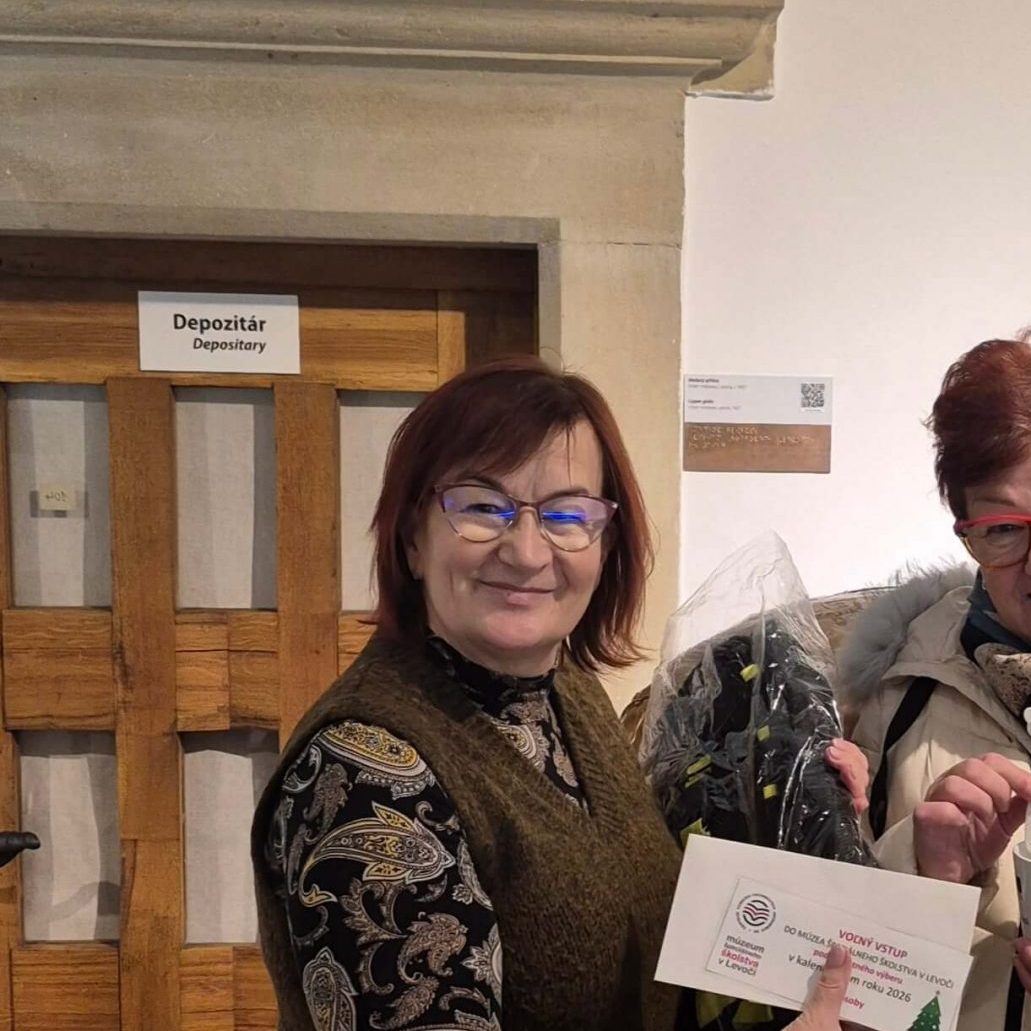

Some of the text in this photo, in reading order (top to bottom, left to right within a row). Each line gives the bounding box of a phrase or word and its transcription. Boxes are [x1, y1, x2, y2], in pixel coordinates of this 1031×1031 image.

[173, 313, 267, 335] Depozitár
[193, 337, 266, 354] Depositary
[784, 925, 796, 936] DO
[726, 935, 765, 953] múzeum
[875, 941, 908, 959] VSTUP
[720, 948, 759, 968] školstva
[725, 959, 757, 976] Levoči
[788, 954, 794, 962] v
[862, 978, 884, 994] roku
[886, 986, 912, 1003] 2026
